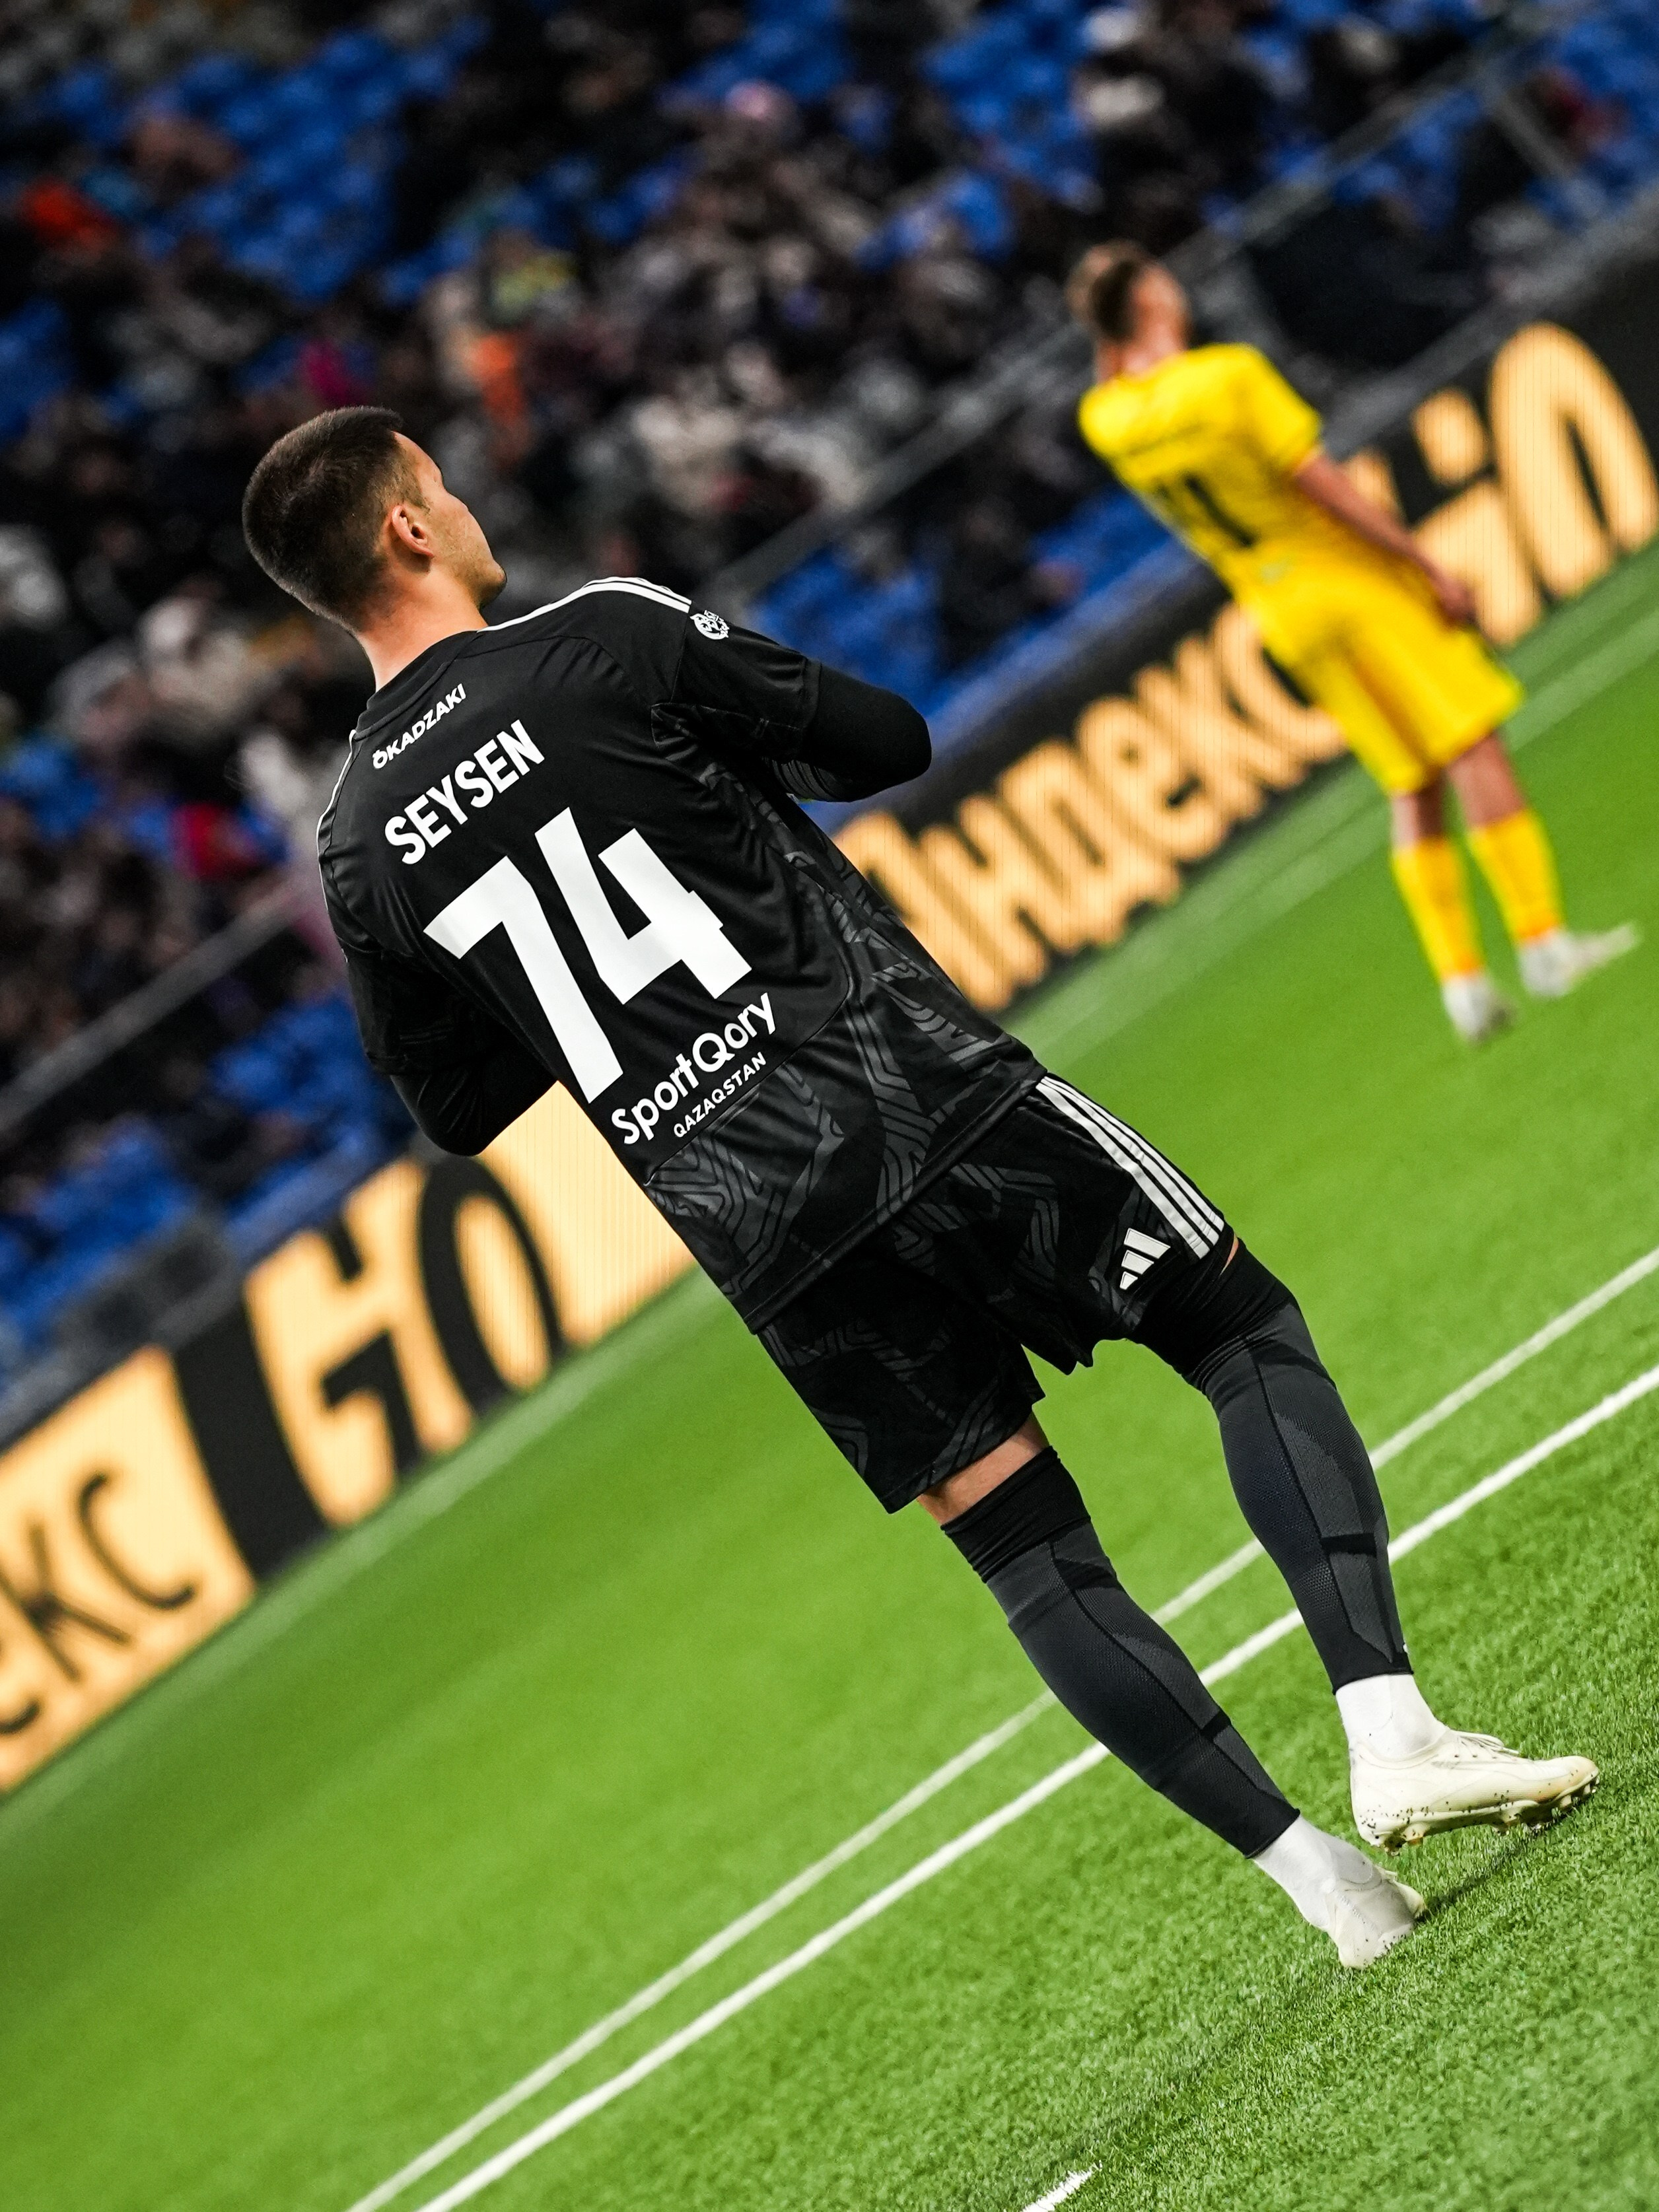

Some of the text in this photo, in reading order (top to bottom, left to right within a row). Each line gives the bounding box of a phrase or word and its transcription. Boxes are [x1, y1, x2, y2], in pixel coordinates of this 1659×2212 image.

[384, 719, 545, 864] SEYSEN
[423, 806, 752, 1104] 74
[611, 992, 776, 1144] SportQory
[673, 1051, 767, 1138] QAZAQSTAN
